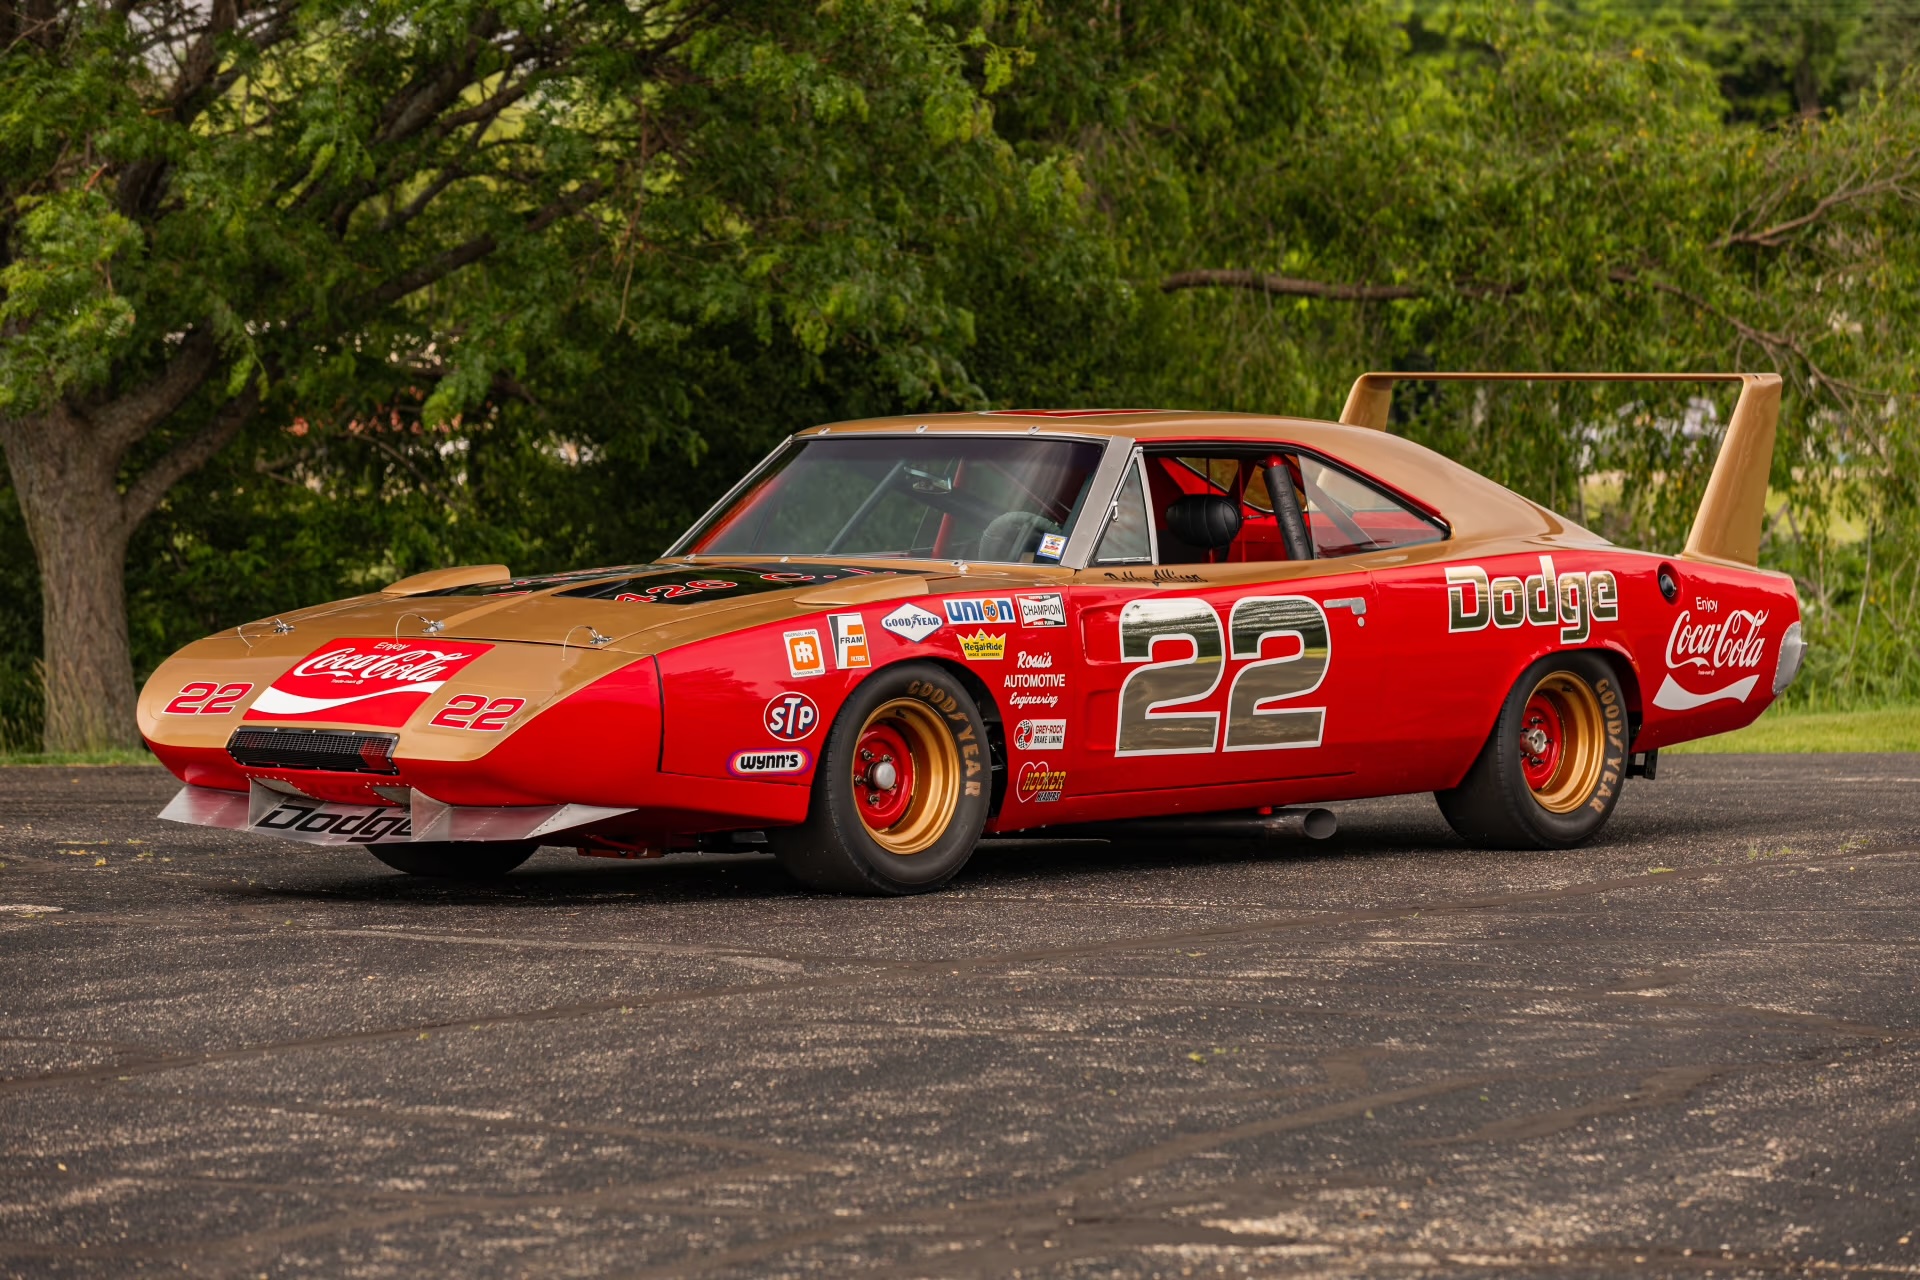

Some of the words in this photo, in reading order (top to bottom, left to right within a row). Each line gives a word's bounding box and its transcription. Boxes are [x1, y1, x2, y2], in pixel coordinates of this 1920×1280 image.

[1444, 555, 1619, 645] Dodge
[1696, 597, 1718, 613] Enjoy
[985, 604, 997, 617] 76
[1023, 604, 1061, 616] CHAMPION
[374, 642, 411, 651] Enjoy
[840, 636, 863, 645] FRAM
[1665, 609, 1770, 669] Coca-Cola
[293, 647, 472, 682] Coca-Cola
[1003, 674, 1066, 688] AUTOMOTIVE
[1114, 595, 1331, 758] 22
[161, 681, 255, 716] 22
[1009, 692, 1059, 709] Engineering
[428, 693, 527, 732] 22
[769, 697, 815, 737] STP
[1035, 725, 1063, 734] GREY-ROCK
[1022, 771, 1067, 791] HOOKER
